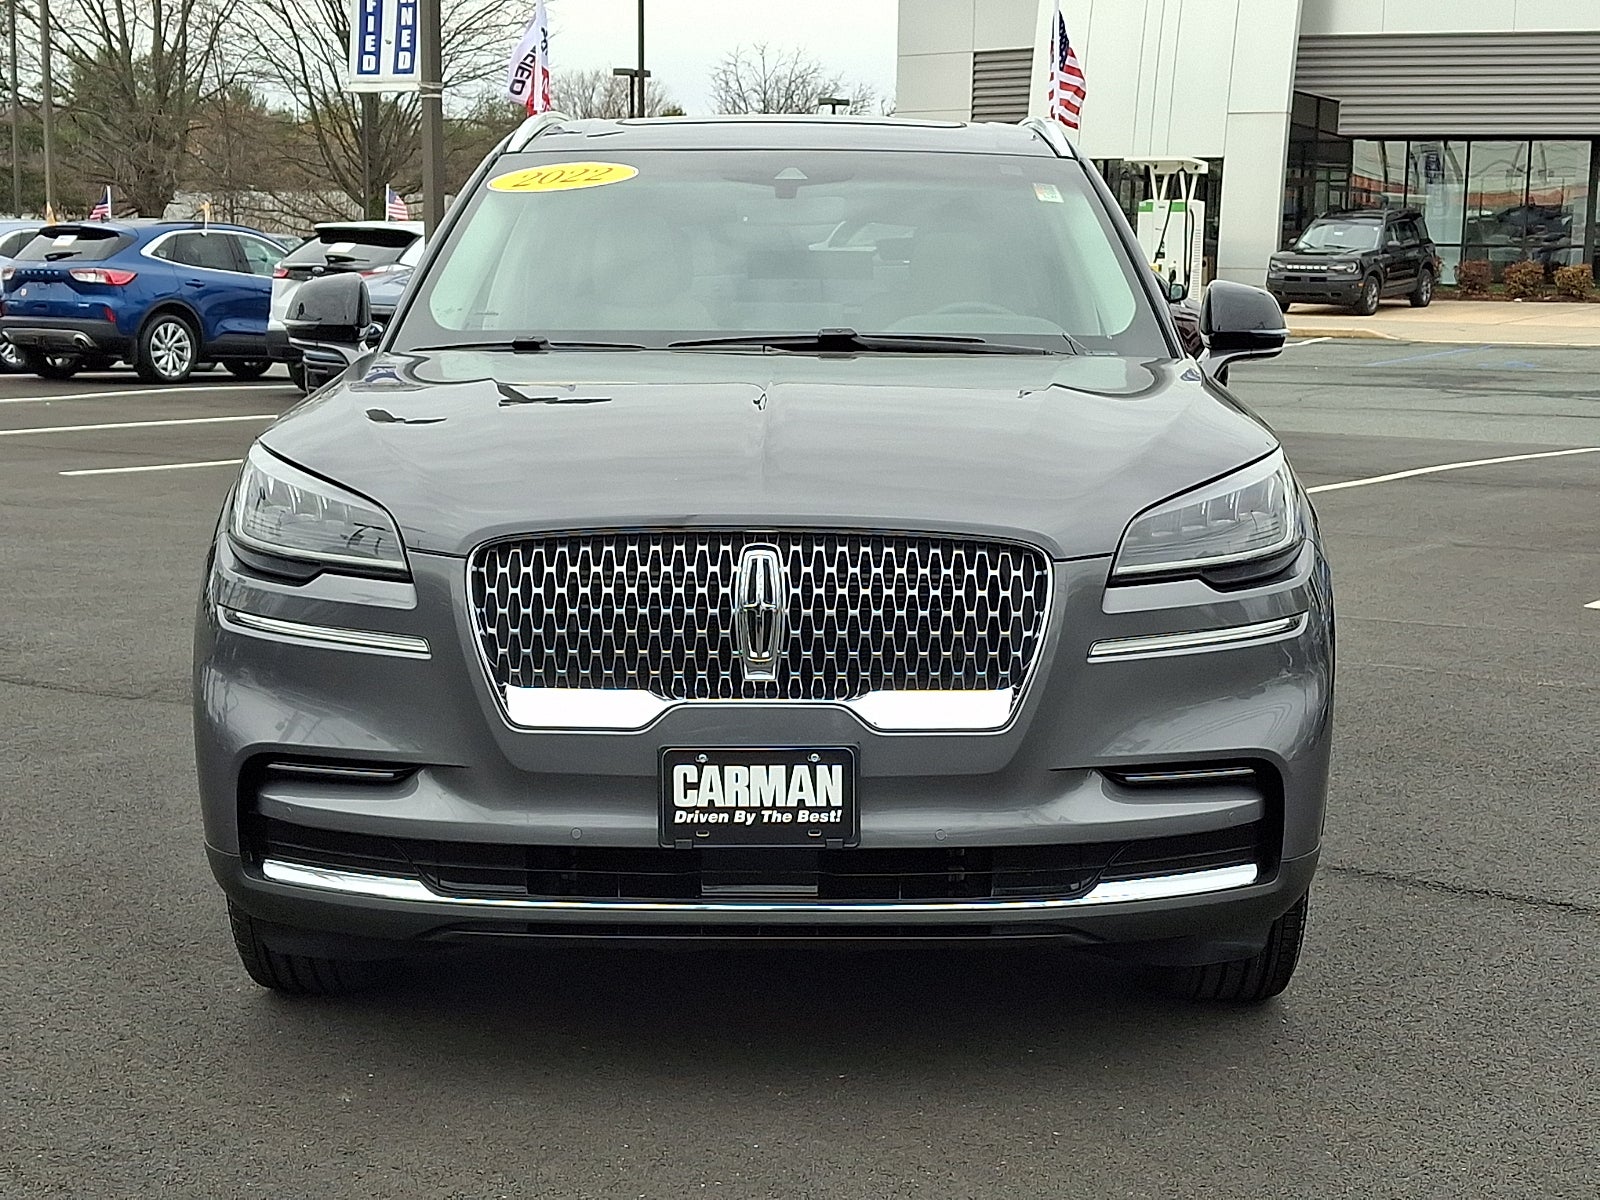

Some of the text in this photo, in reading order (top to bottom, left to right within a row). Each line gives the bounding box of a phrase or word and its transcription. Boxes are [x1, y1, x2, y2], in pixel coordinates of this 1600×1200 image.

[397, 0, 415, 70] NED
[511, 167, 613, 188] 2022
[673, 764, 843, 808] CARMAN
[674, 809, 842, 826] Driven By The Best!
